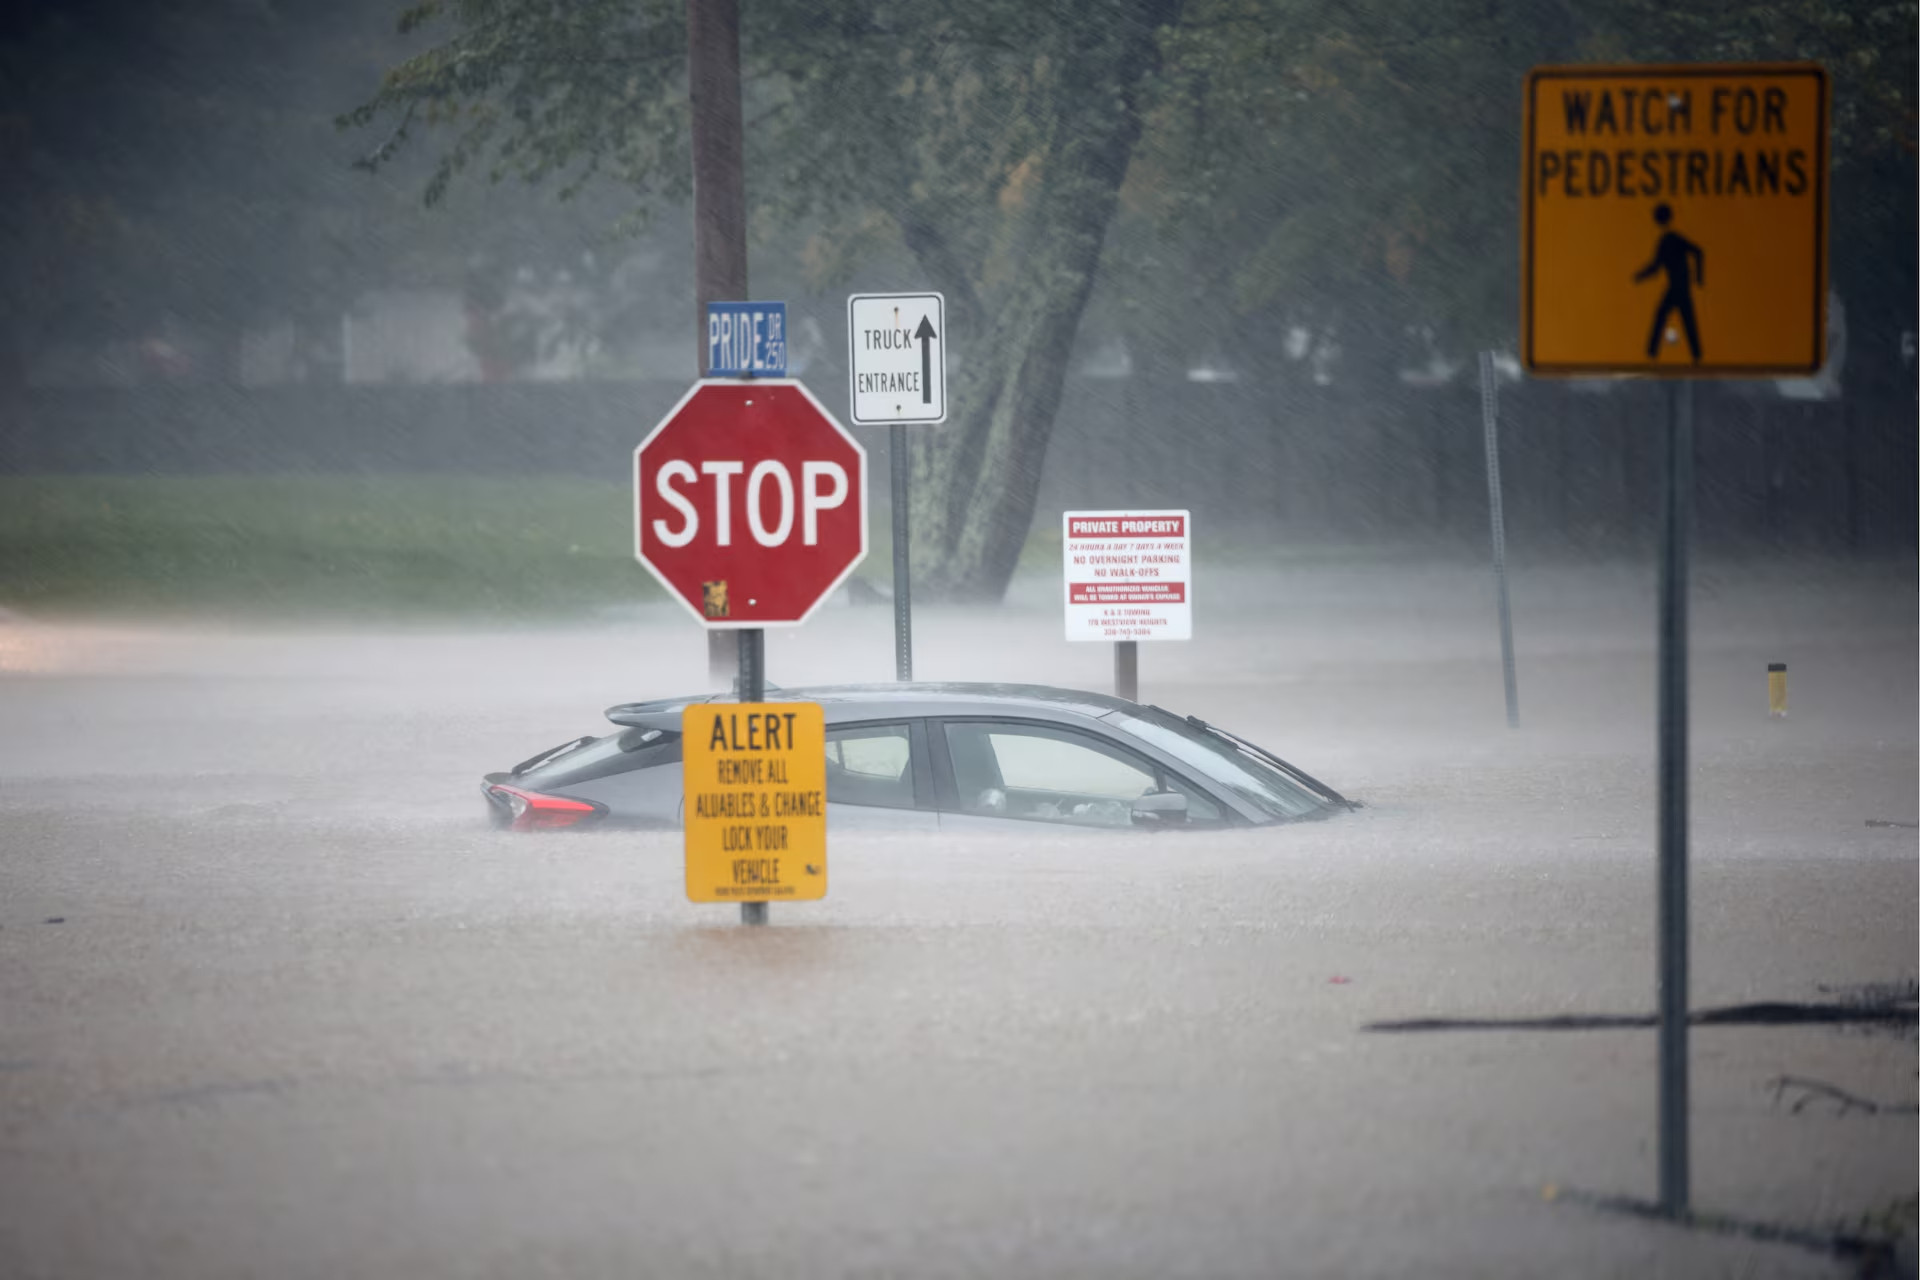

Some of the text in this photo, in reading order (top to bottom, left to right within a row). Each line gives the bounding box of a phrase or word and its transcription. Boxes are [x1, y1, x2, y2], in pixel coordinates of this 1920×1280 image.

[1561, 86, 1788, 136] WATCH FOR
[1538, 149, 1810, 197] PEDESTRIANS
[709, 312, 782, 370] PRIDE DR
[864, 329, 912, 350] TRUCK
[765, 341, 785, 369] 250
[859, 372, 920, 393] ENTRANCE
[653, 459, 849, 548] STOP
[1072, 520, 1180, 534] PRIVATE PROPERTY
[1073, 554, 1180, 564] NO OVERNIGHT PARKING
[1094, 567, 1160, 577] NO WALK-OFFS
[709, 713, 797, 751] ALERT
[718, 759, 788, 784] REMOVE ALL
[760, 792, 770, 817] &
[775, 791, 823, 817] CHANGE
[723, 825, 788, 851] LOCK YOUR
[732, 858, 780, 884] VEHICLE
